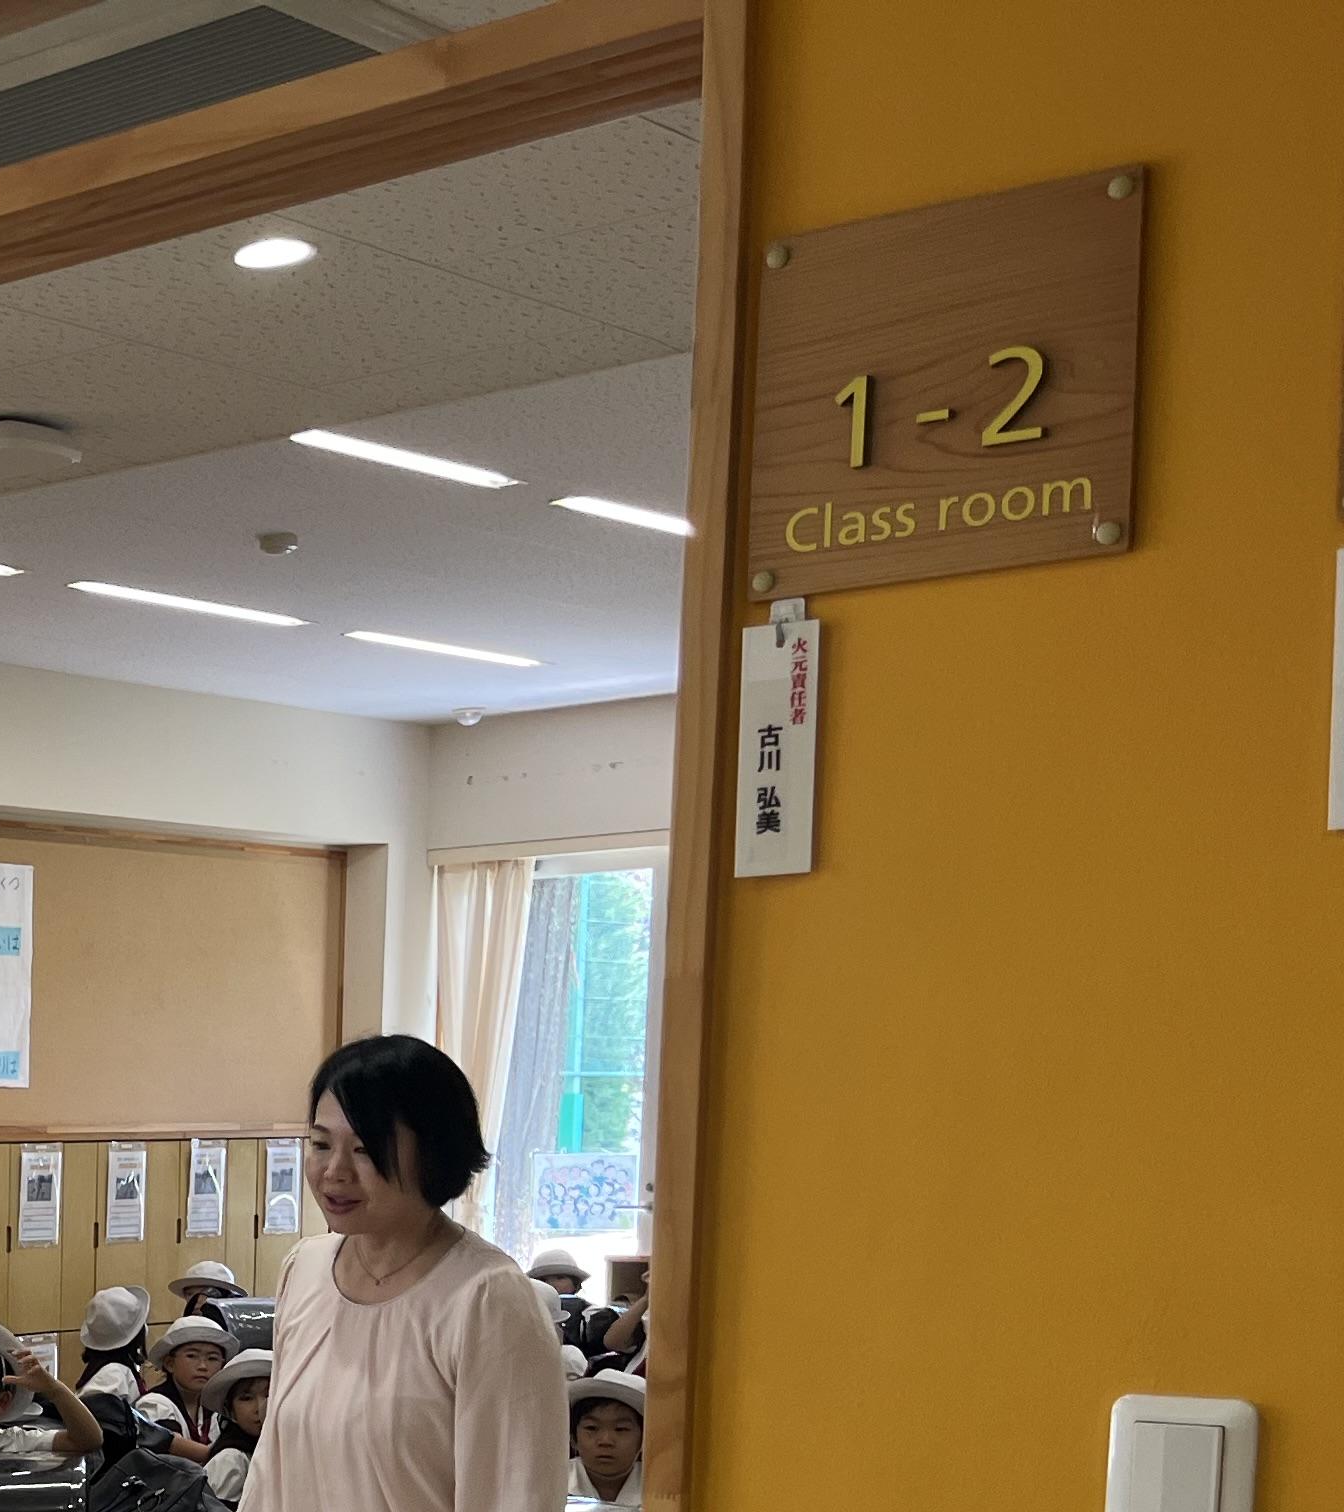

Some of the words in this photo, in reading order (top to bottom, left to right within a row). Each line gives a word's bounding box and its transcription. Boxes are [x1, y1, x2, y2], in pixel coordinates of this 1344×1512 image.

[783, 500, 917, 554] Class
[937, 475, 1094, 532] room
[790, 636, 809, 726] 火元責任者
